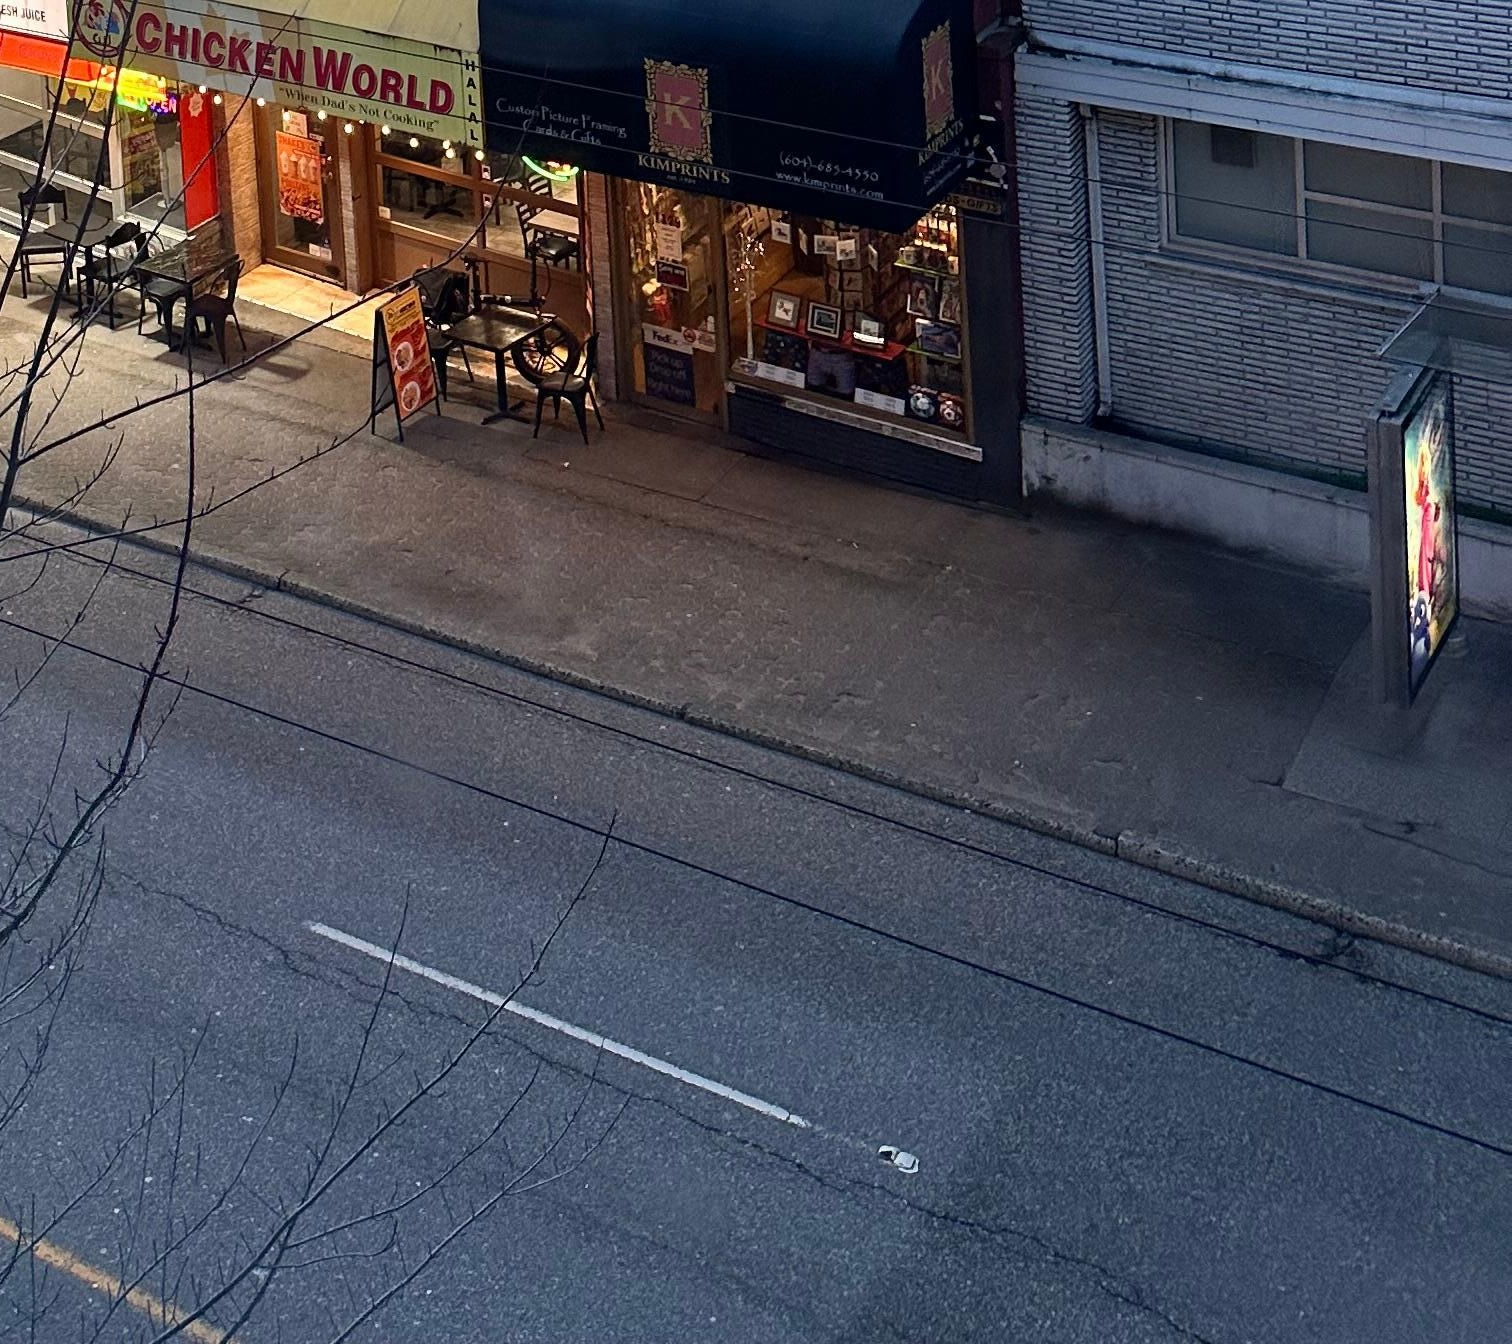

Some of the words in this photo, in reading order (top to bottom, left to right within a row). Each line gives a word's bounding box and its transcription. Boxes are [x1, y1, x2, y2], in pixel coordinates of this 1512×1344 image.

[21, 8, 47, 23] JUICE
[136, 12, 305, 84] CHICKEN
[313, 46, 455, 115] WORLD
[322, 95, 356, 112] Dad's
[358, 103, 380, 118] Not
[464, 58, 479, 142] HALAL
[541, 105, 580, 126] Picture
[582, 114, 628, 139] Framing
[637, 153, 730, 184] KIMPRINTS
[775, 171, 885, 200] www.kimprints.com
